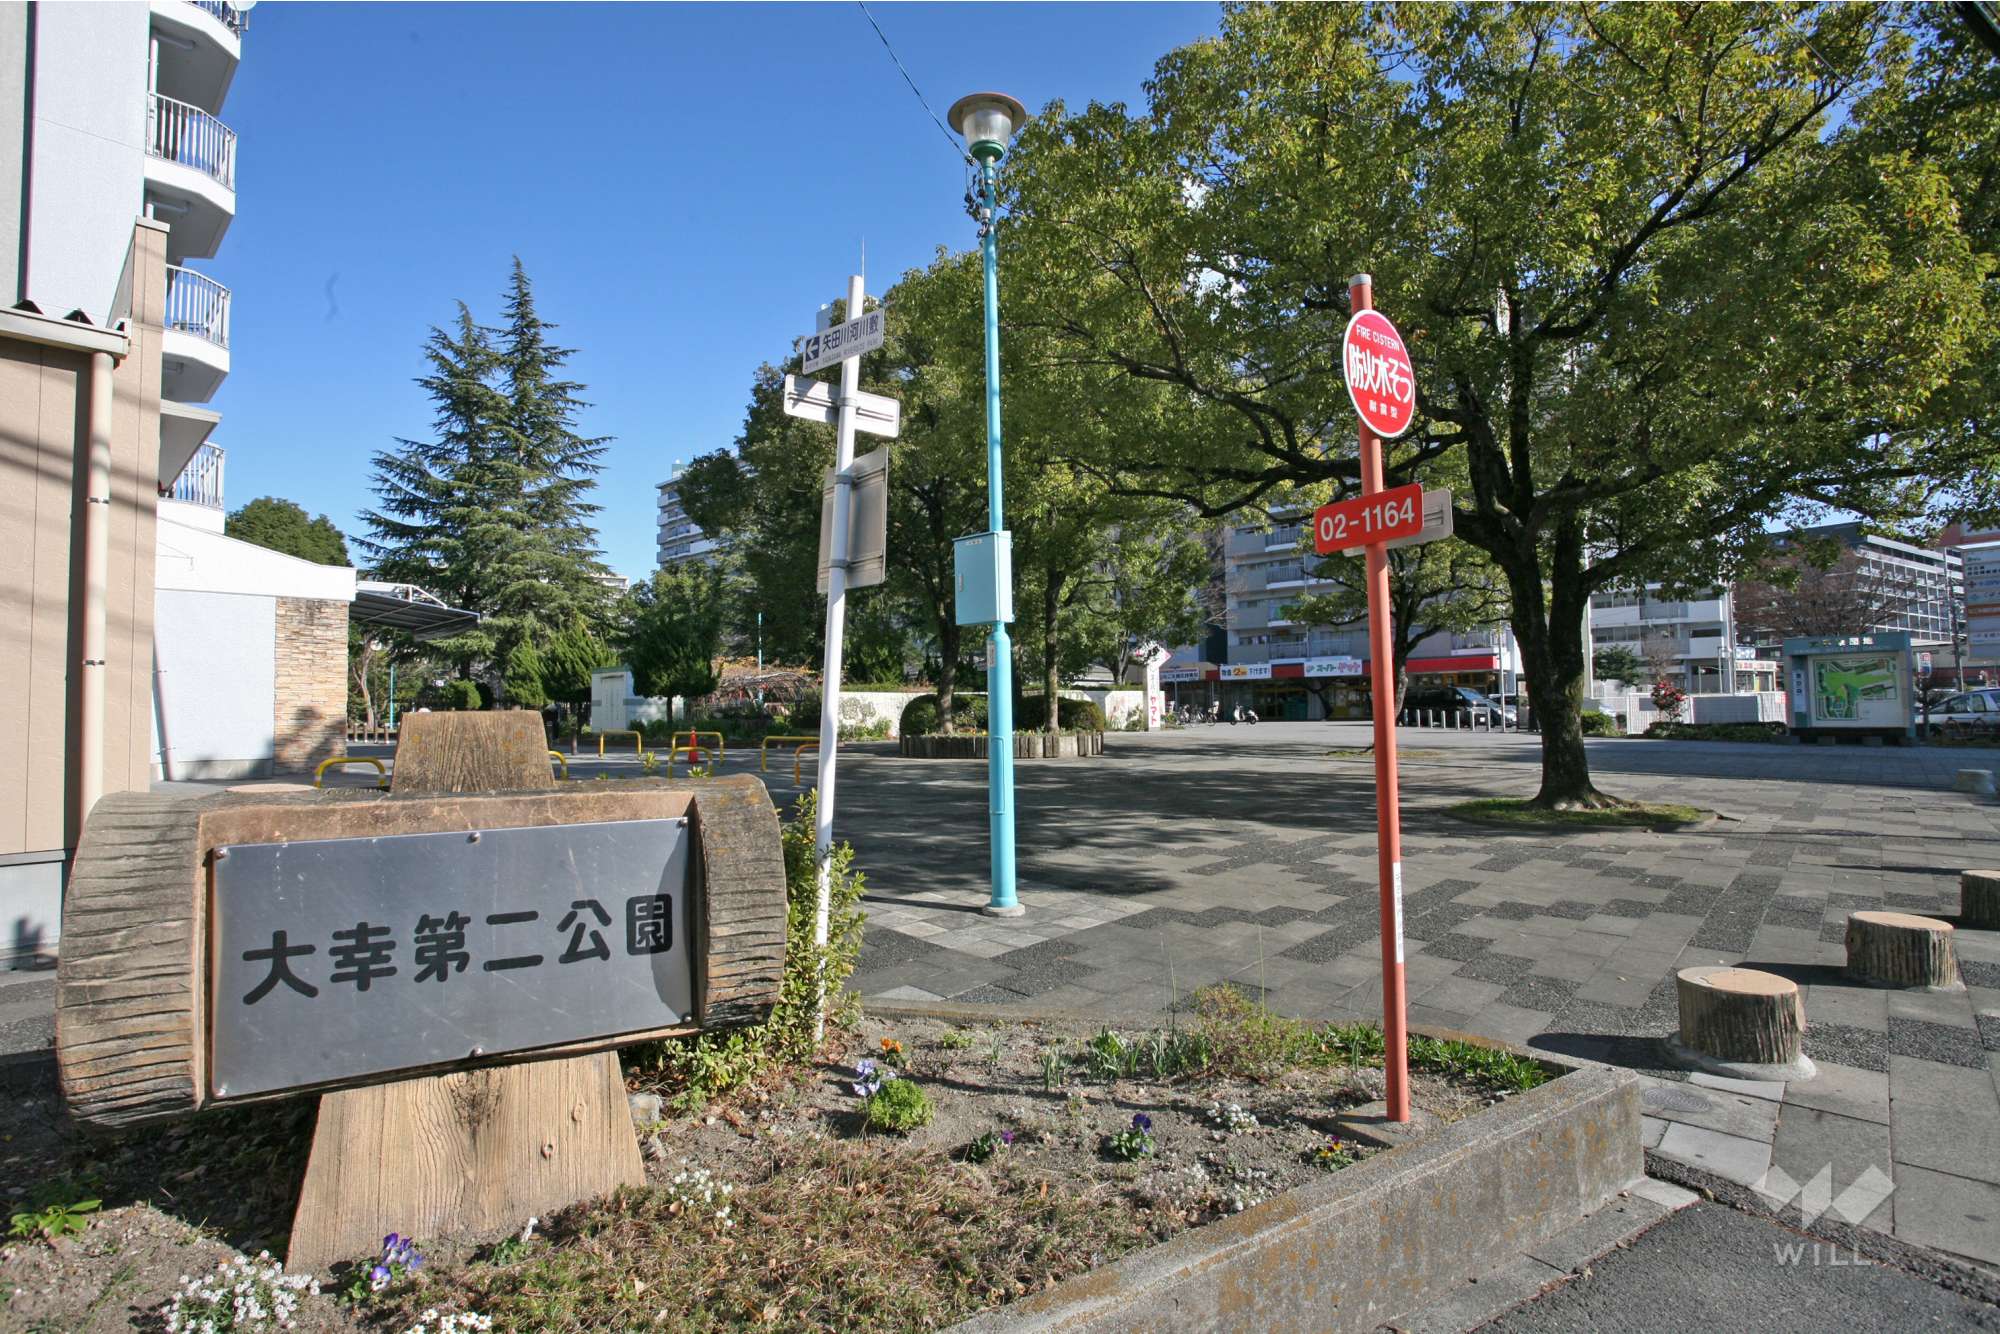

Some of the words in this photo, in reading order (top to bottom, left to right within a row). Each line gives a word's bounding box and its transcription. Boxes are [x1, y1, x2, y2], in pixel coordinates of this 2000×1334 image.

[822, 314, 879, 353] 矢田川河川敷
[1356, 324, 1371, 341] FIRE
[1372, 331, 1400, 352] CISTERN
[1348, 342, 1412, 404] 防火水そう
[1320, 496, 1415, 541] 02-1164
[242, 892, 674, 1005] 大幸第二公園
